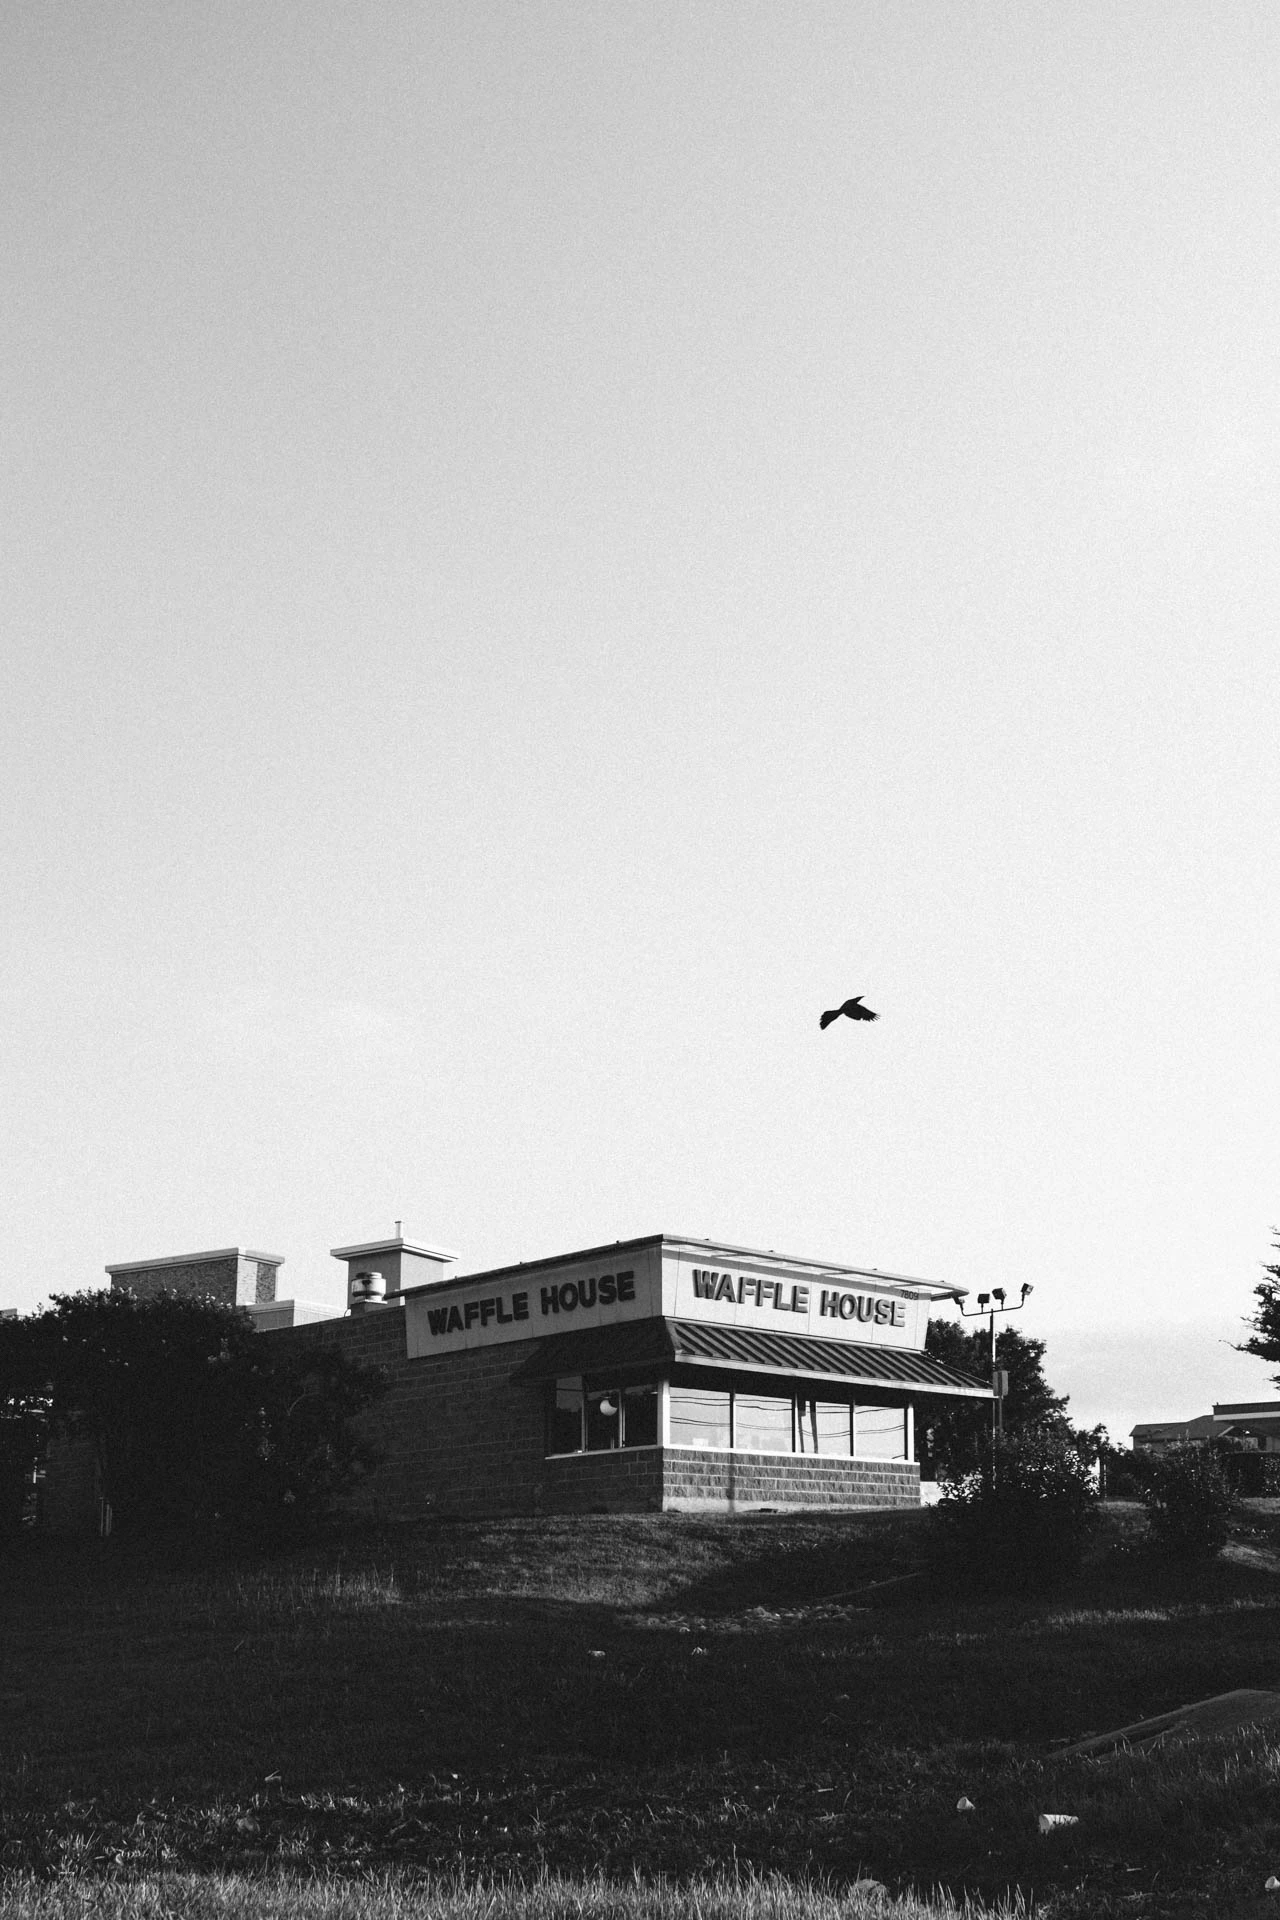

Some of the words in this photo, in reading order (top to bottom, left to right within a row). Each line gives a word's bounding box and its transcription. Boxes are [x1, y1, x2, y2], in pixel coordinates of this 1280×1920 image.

[427, 1291, 529, 1336] WAFFLE
[540, 1270, 636, 1315] HOUSE
[692, 1269, 809, 1313] WAFFLE
[819, 1290, 906, 1327] HOUSE
[900, 1289, 919, 1300] 7809
